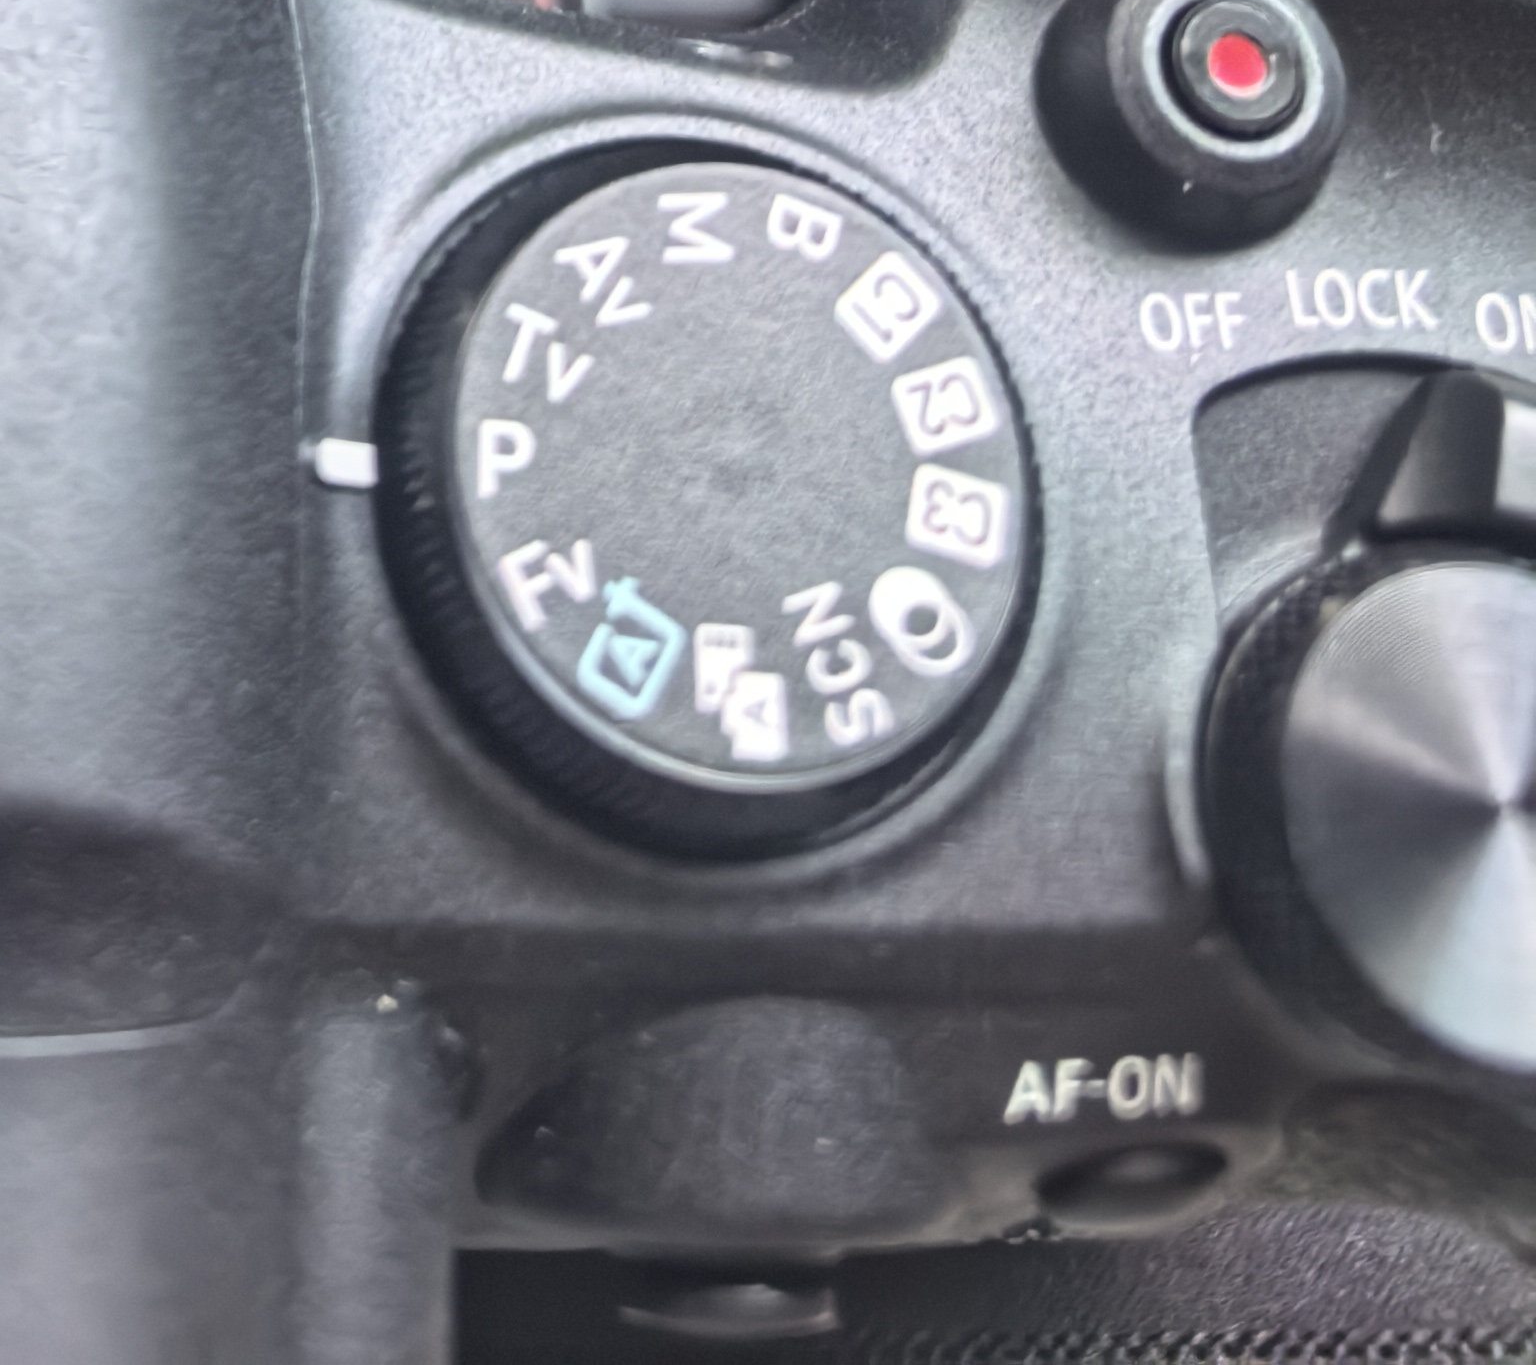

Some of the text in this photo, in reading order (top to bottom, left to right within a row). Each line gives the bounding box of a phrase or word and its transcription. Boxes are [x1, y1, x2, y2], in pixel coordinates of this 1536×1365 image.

[656, 191, 736, 264] M
[766, 193, 844, 262] B
[553, 235, 653, 327] Av
[1139, 292, 1248, 351] OFF
[1285, 267, 1441, 331] LOCK
[501, 302, 596, 404] Tv
[476, 418, 537, 499] P
[498, 538, 597, 632] Fv
[779, 580, 897, 746] SCN
[1001, 1052, 1204, 1124] AF-ON
